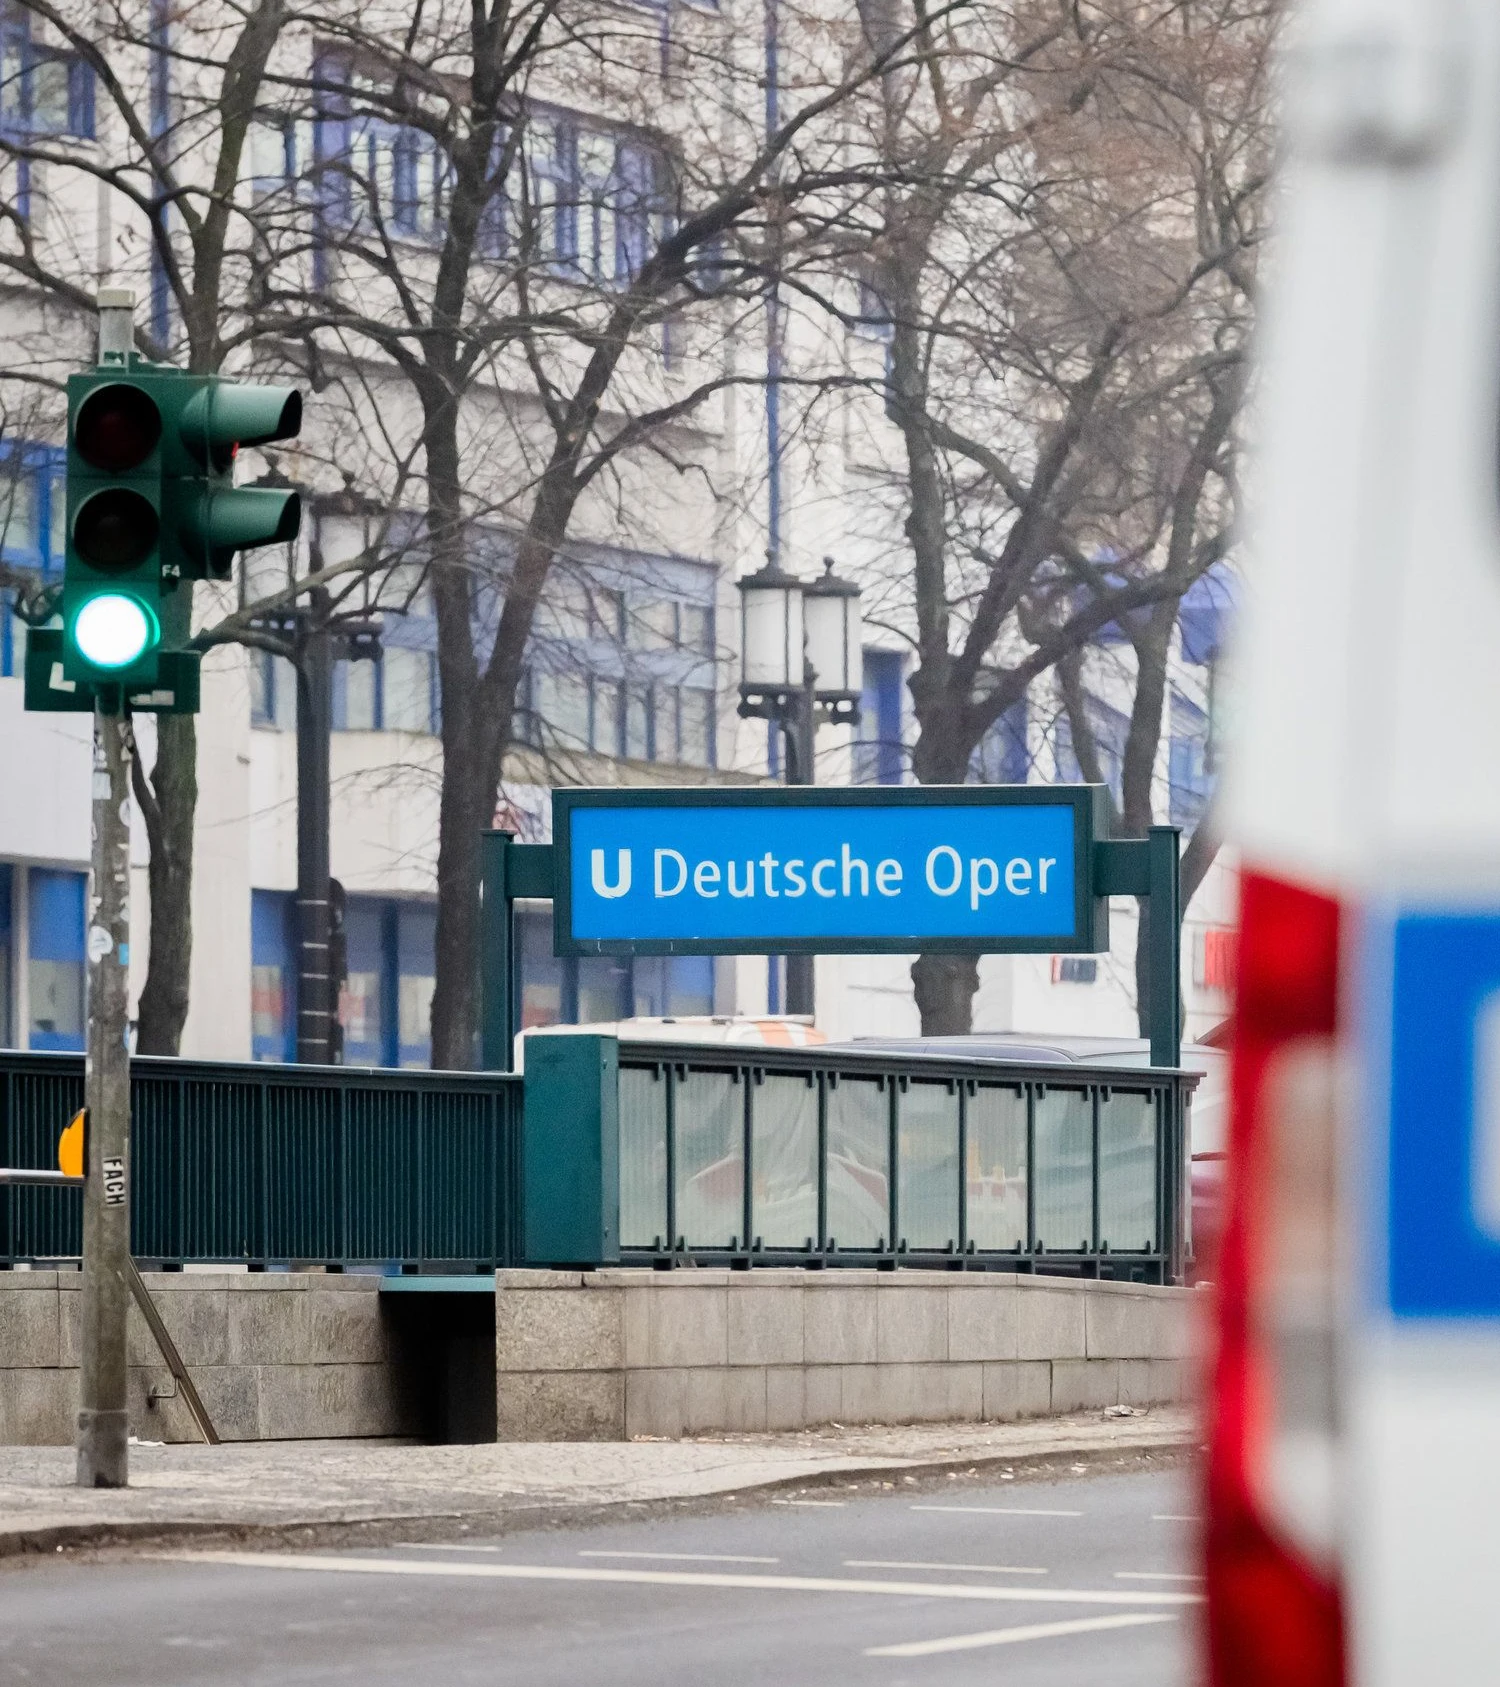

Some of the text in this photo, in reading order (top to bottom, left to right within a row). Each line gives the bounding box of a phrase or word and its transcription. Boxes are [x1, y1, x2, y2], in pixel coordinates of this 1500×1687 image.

[162, 565, 180, 577] F4
[591, 843, 1057, 911] U Deutsche Oper
[104, 1159, 125, 1205] FACH
